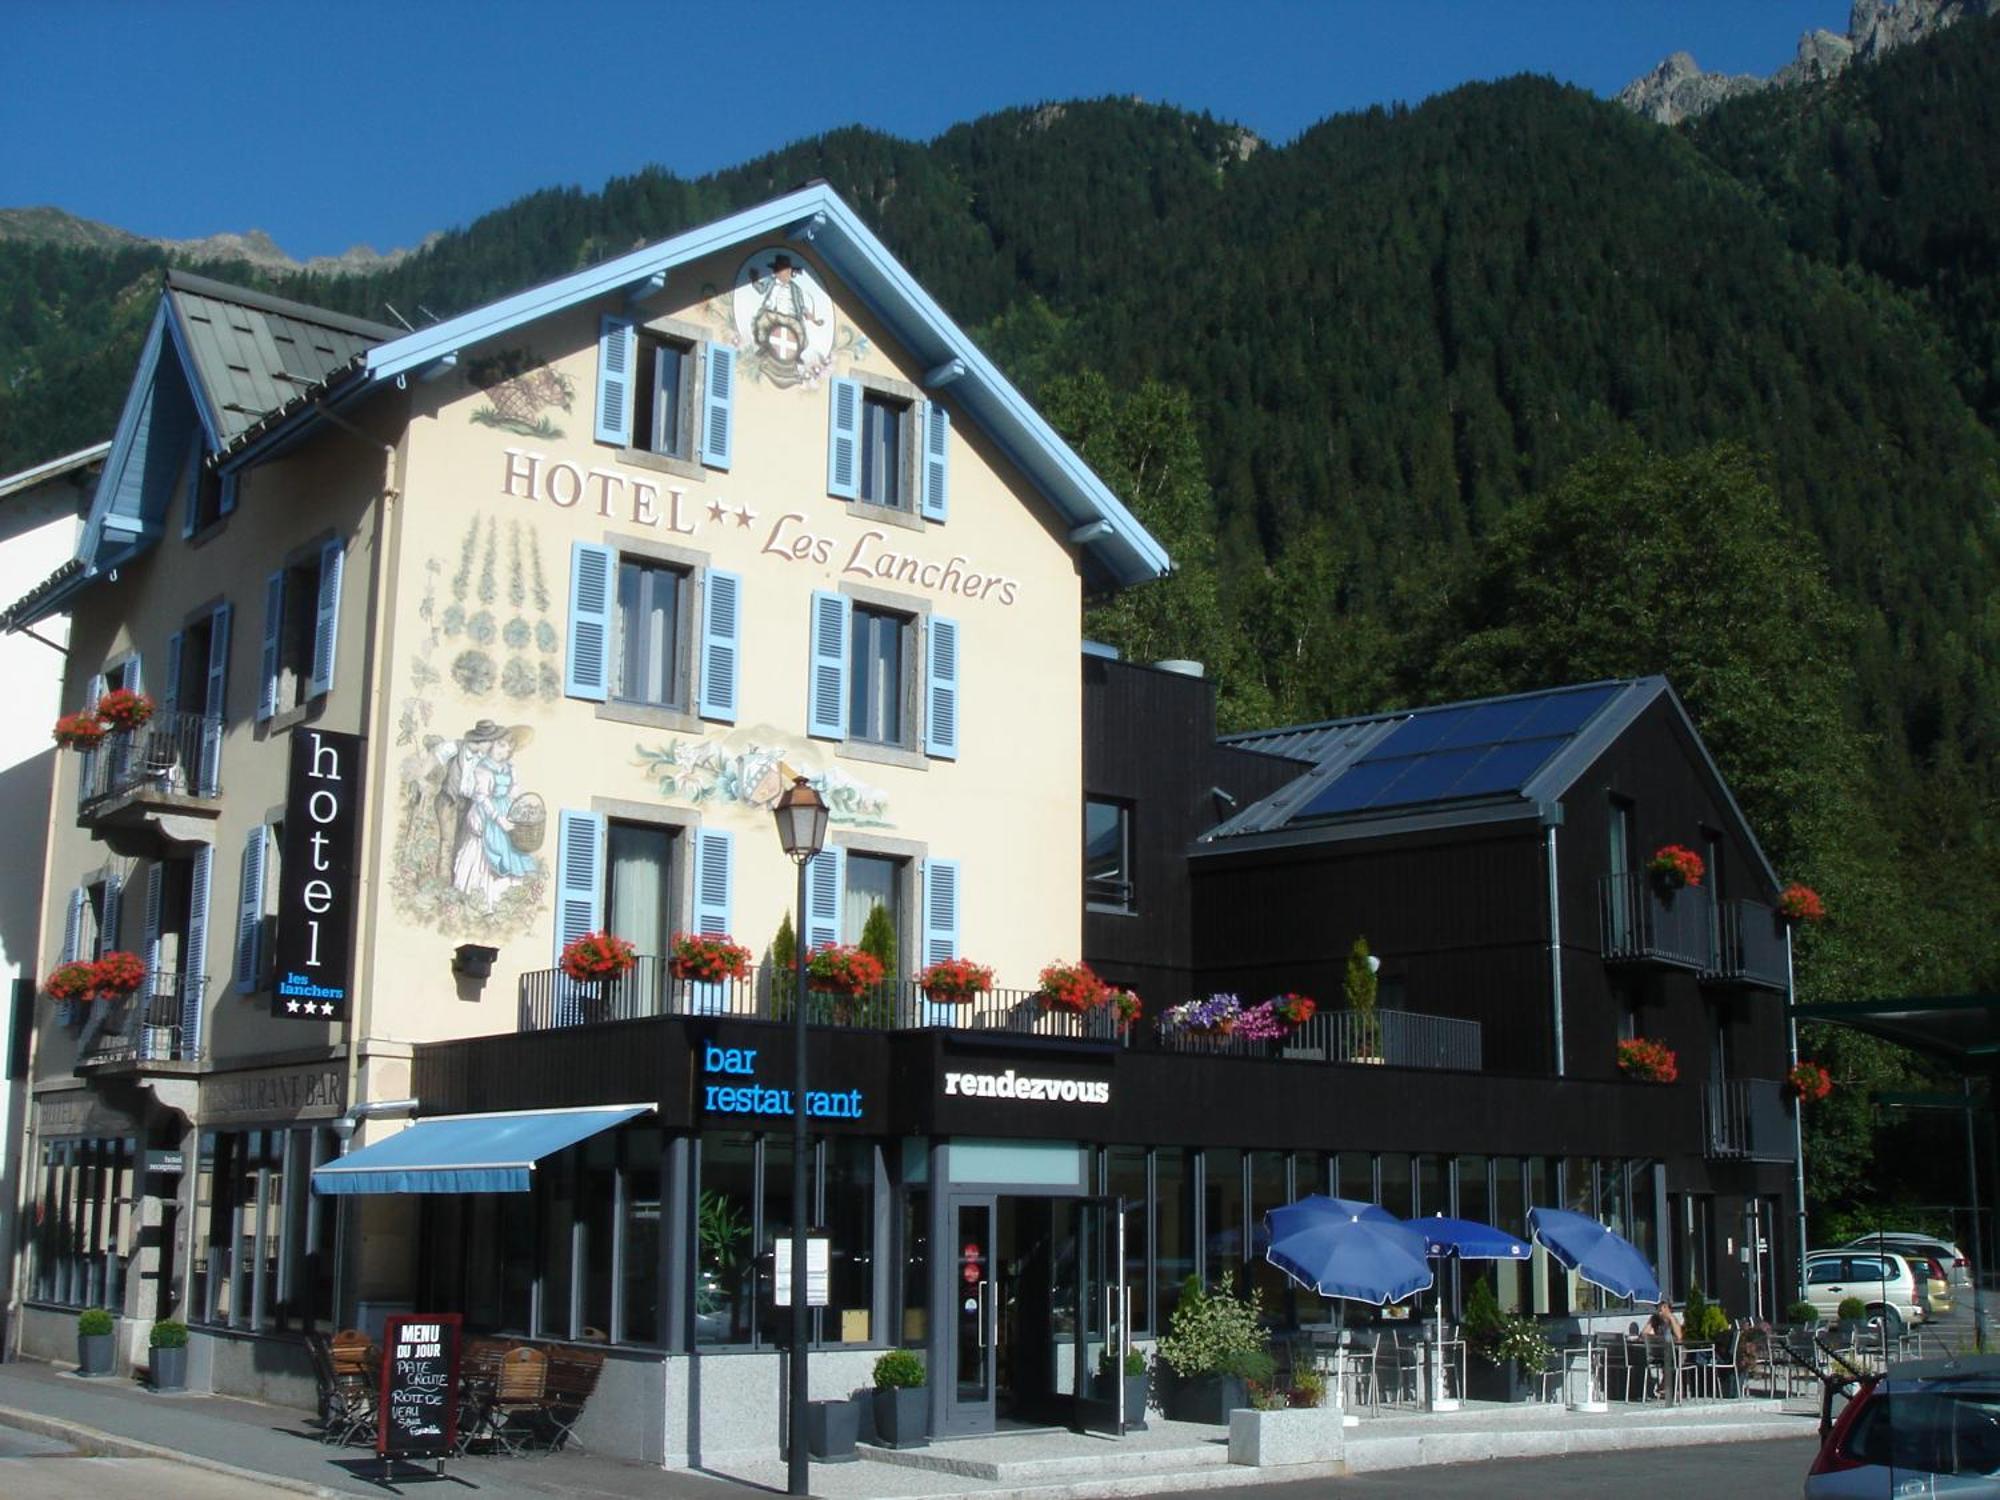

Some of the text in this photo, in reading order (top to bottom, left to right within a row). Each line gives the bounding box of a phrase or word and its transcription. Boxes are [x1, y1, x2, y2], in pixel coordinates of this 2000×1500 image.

[502, 450, 1020, 606] HOTEL Les Lanchers
[302, 733, 342, 967] hotel
[280, 982, 344, 998] lanchers
[287, 972, 309, 985] les
[705, 1041, 757, 1075] bar
[305, 1072, 341, 1107] BAR
[705, 1085, 863, 1118] restaurant
[944, 1069, 1110, 1104] rendezvous
[401, 1325, 440, 1343] MENU
[397, 1344, 441, 1358] DU JOUR
